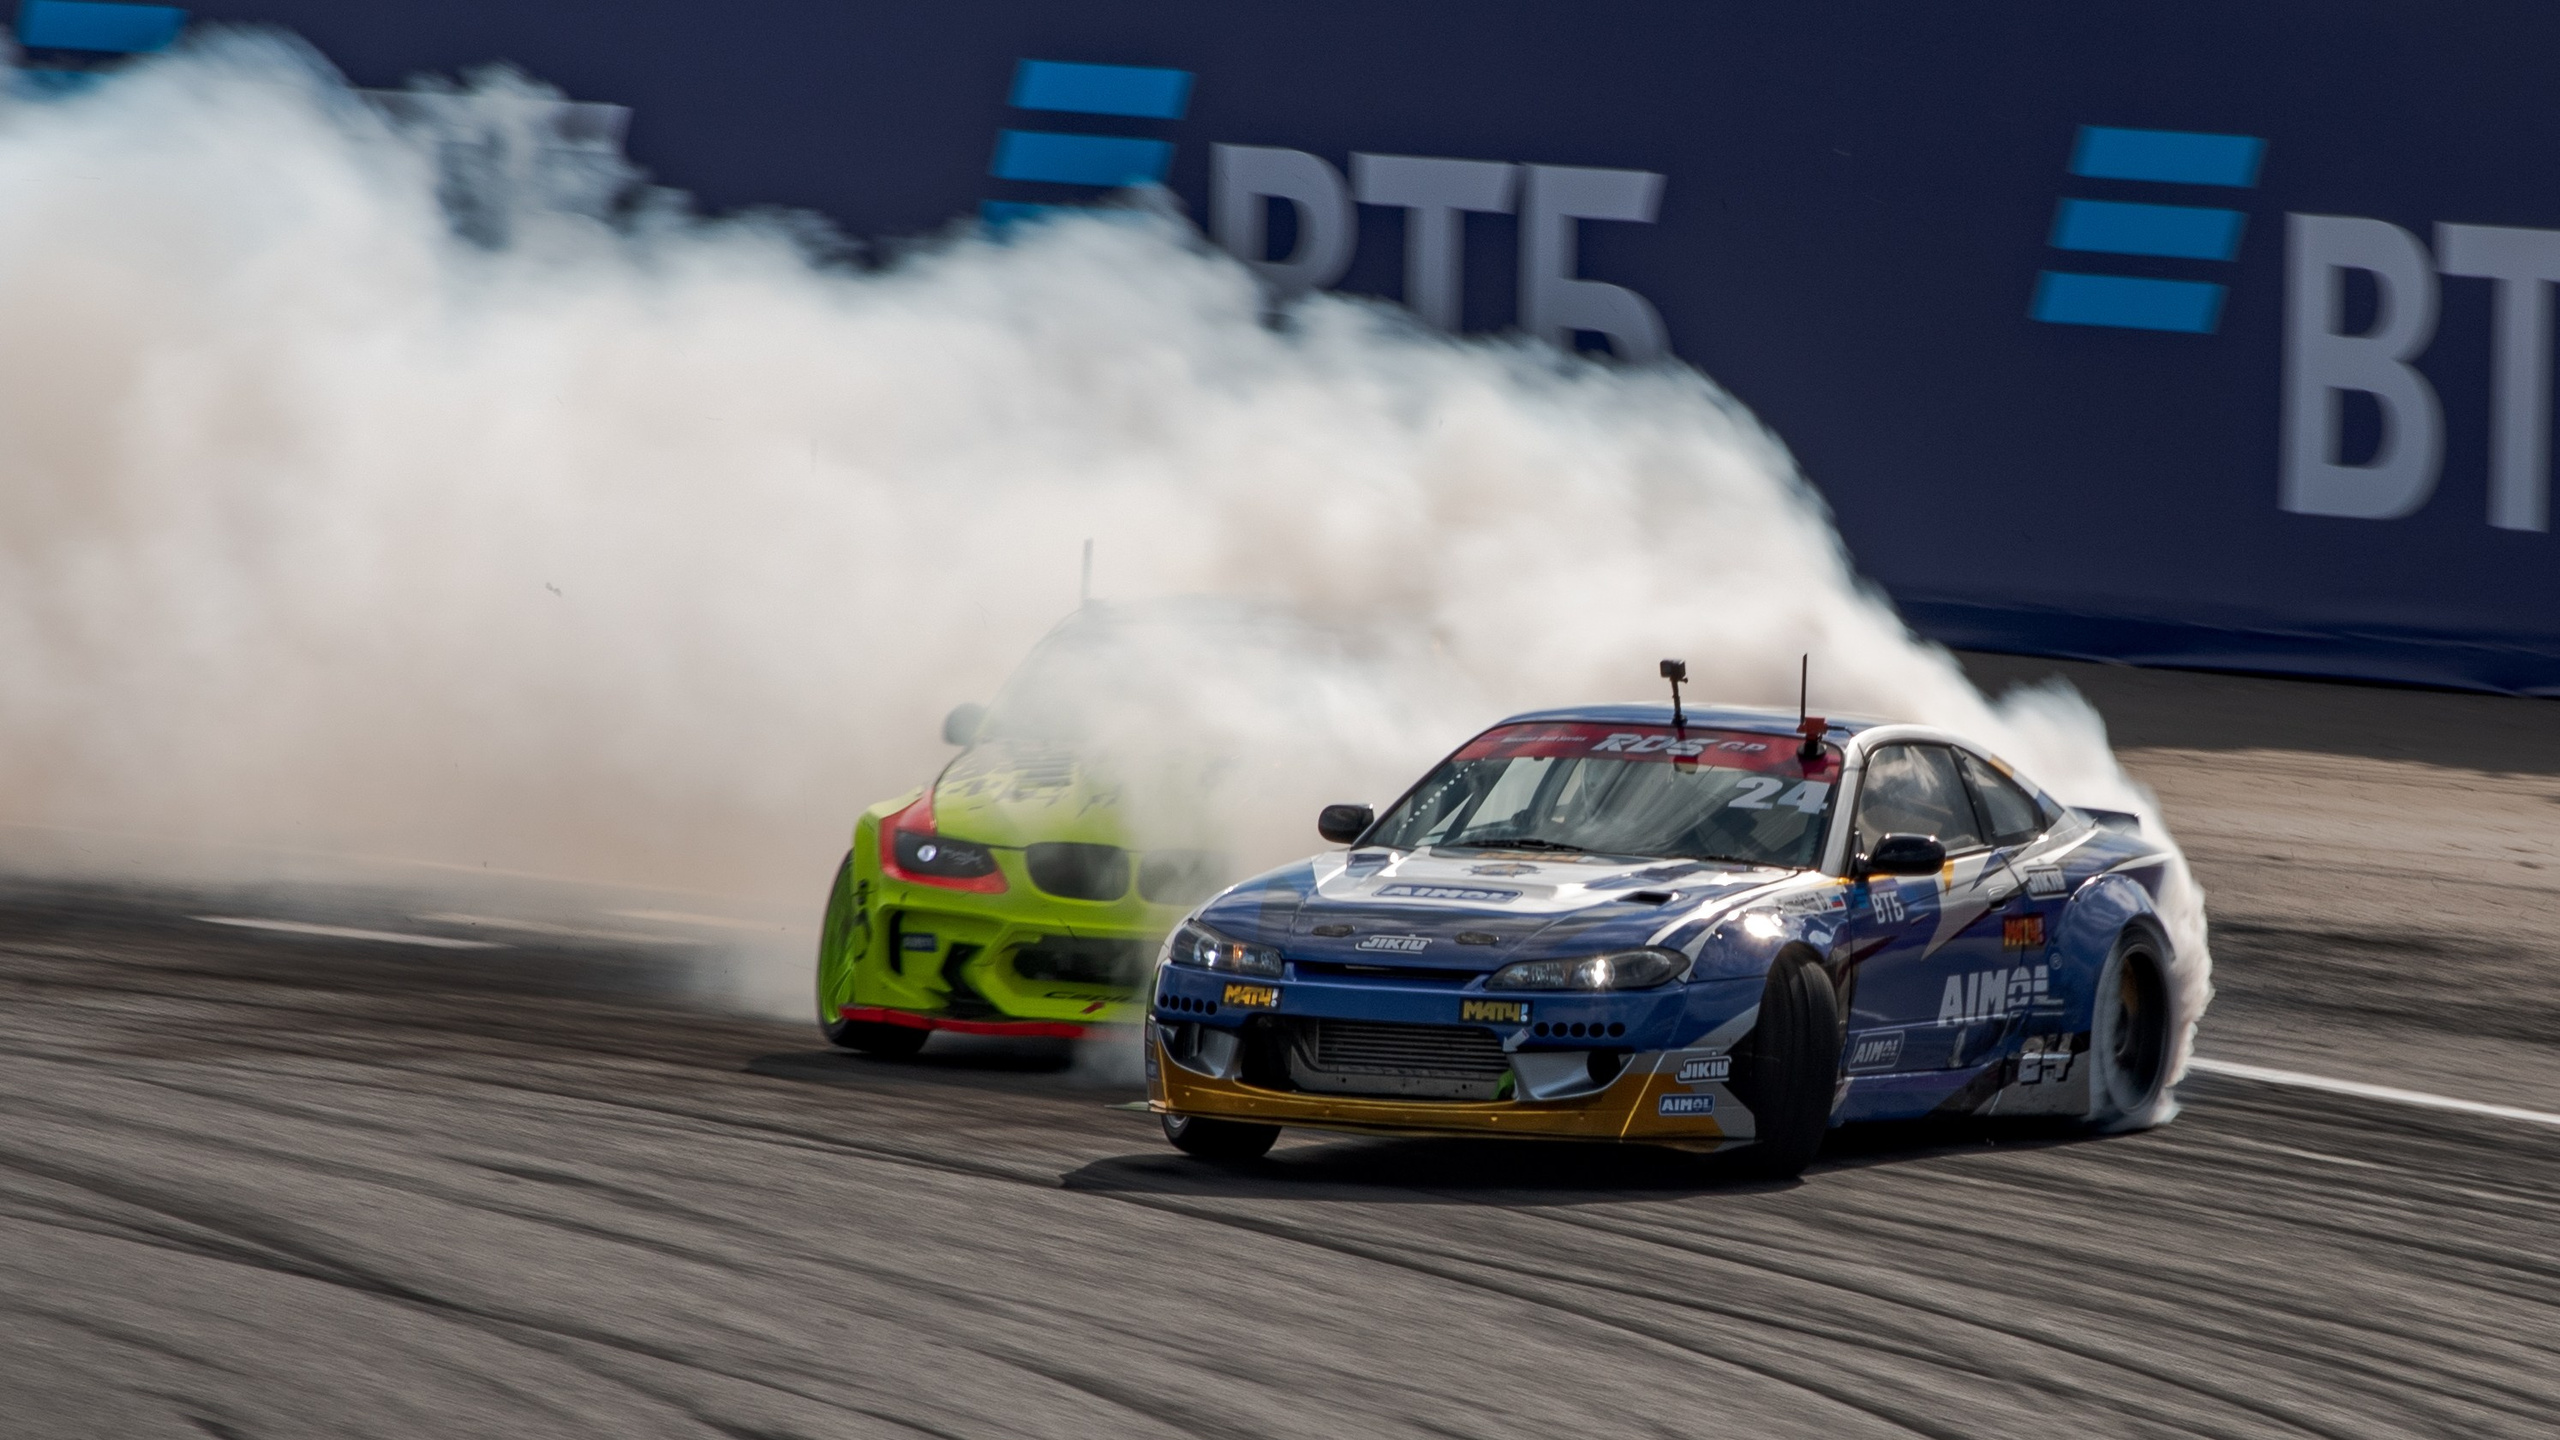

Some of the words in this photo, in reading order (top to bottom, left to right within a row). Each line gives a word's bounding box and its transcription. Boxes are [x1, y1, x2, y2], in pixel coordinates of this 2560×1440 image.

[2277, 211, 2560, 533] ВТ
[1592, 733, 1720, 756] RDS
[1717, 741, 1767, 753] GP
[1728, 776, 1830, 815] 24
[1381, 886, 1512, 901] AIMOL
[1870, 890, 1904, 924] ВТБ
[1362, 936, 1428, 951] JIKIU
[1937, 965, 2064, 1028] AIMOL
[1679, 1059, 1730, 1079] JIKIU
[1661, 1098, 1712, 1112] AIMOL
